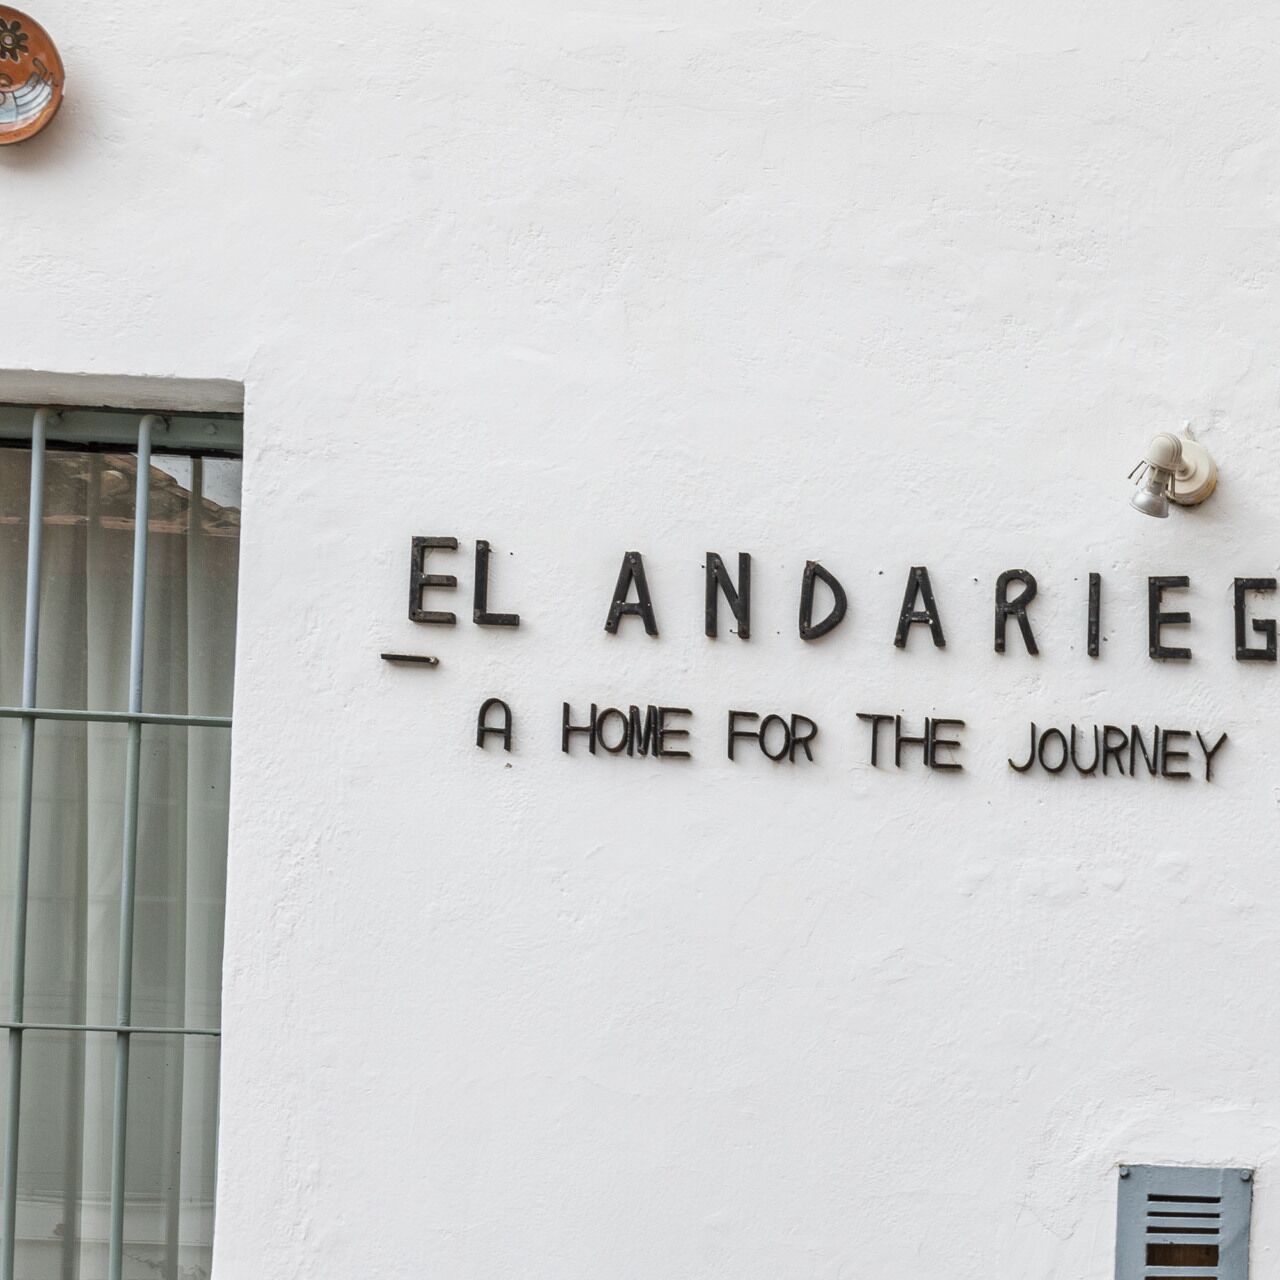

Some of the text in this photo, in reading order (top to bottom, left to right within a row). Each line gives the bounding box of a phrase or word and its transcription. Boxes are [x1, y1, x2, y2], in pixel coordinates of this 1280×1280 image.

[408, 536, 521, 629] EL
[476, 696, 1230, 785] A HOME FOR THE JOURNEY
